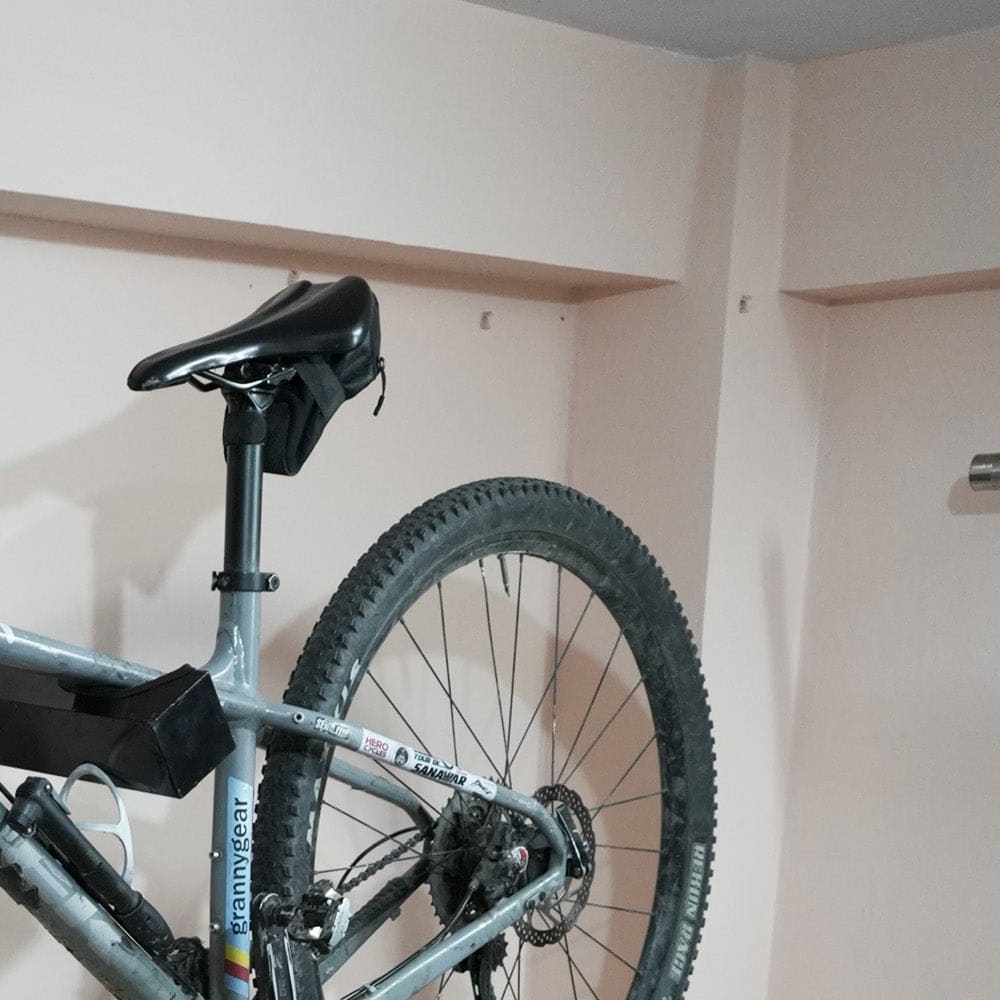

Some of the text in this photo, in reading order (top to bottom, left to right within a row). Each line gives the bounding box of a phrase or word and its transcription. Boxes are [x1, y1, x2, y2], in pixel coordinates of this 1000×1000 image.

[365, 737, 389, 751] HERO
[414, 753, 431, 764] TOUR
[414, 763, 467, 786] SANAWAR
[231, 797, 250, 936] grannygear
[685, 844, 706, 919] REKON
